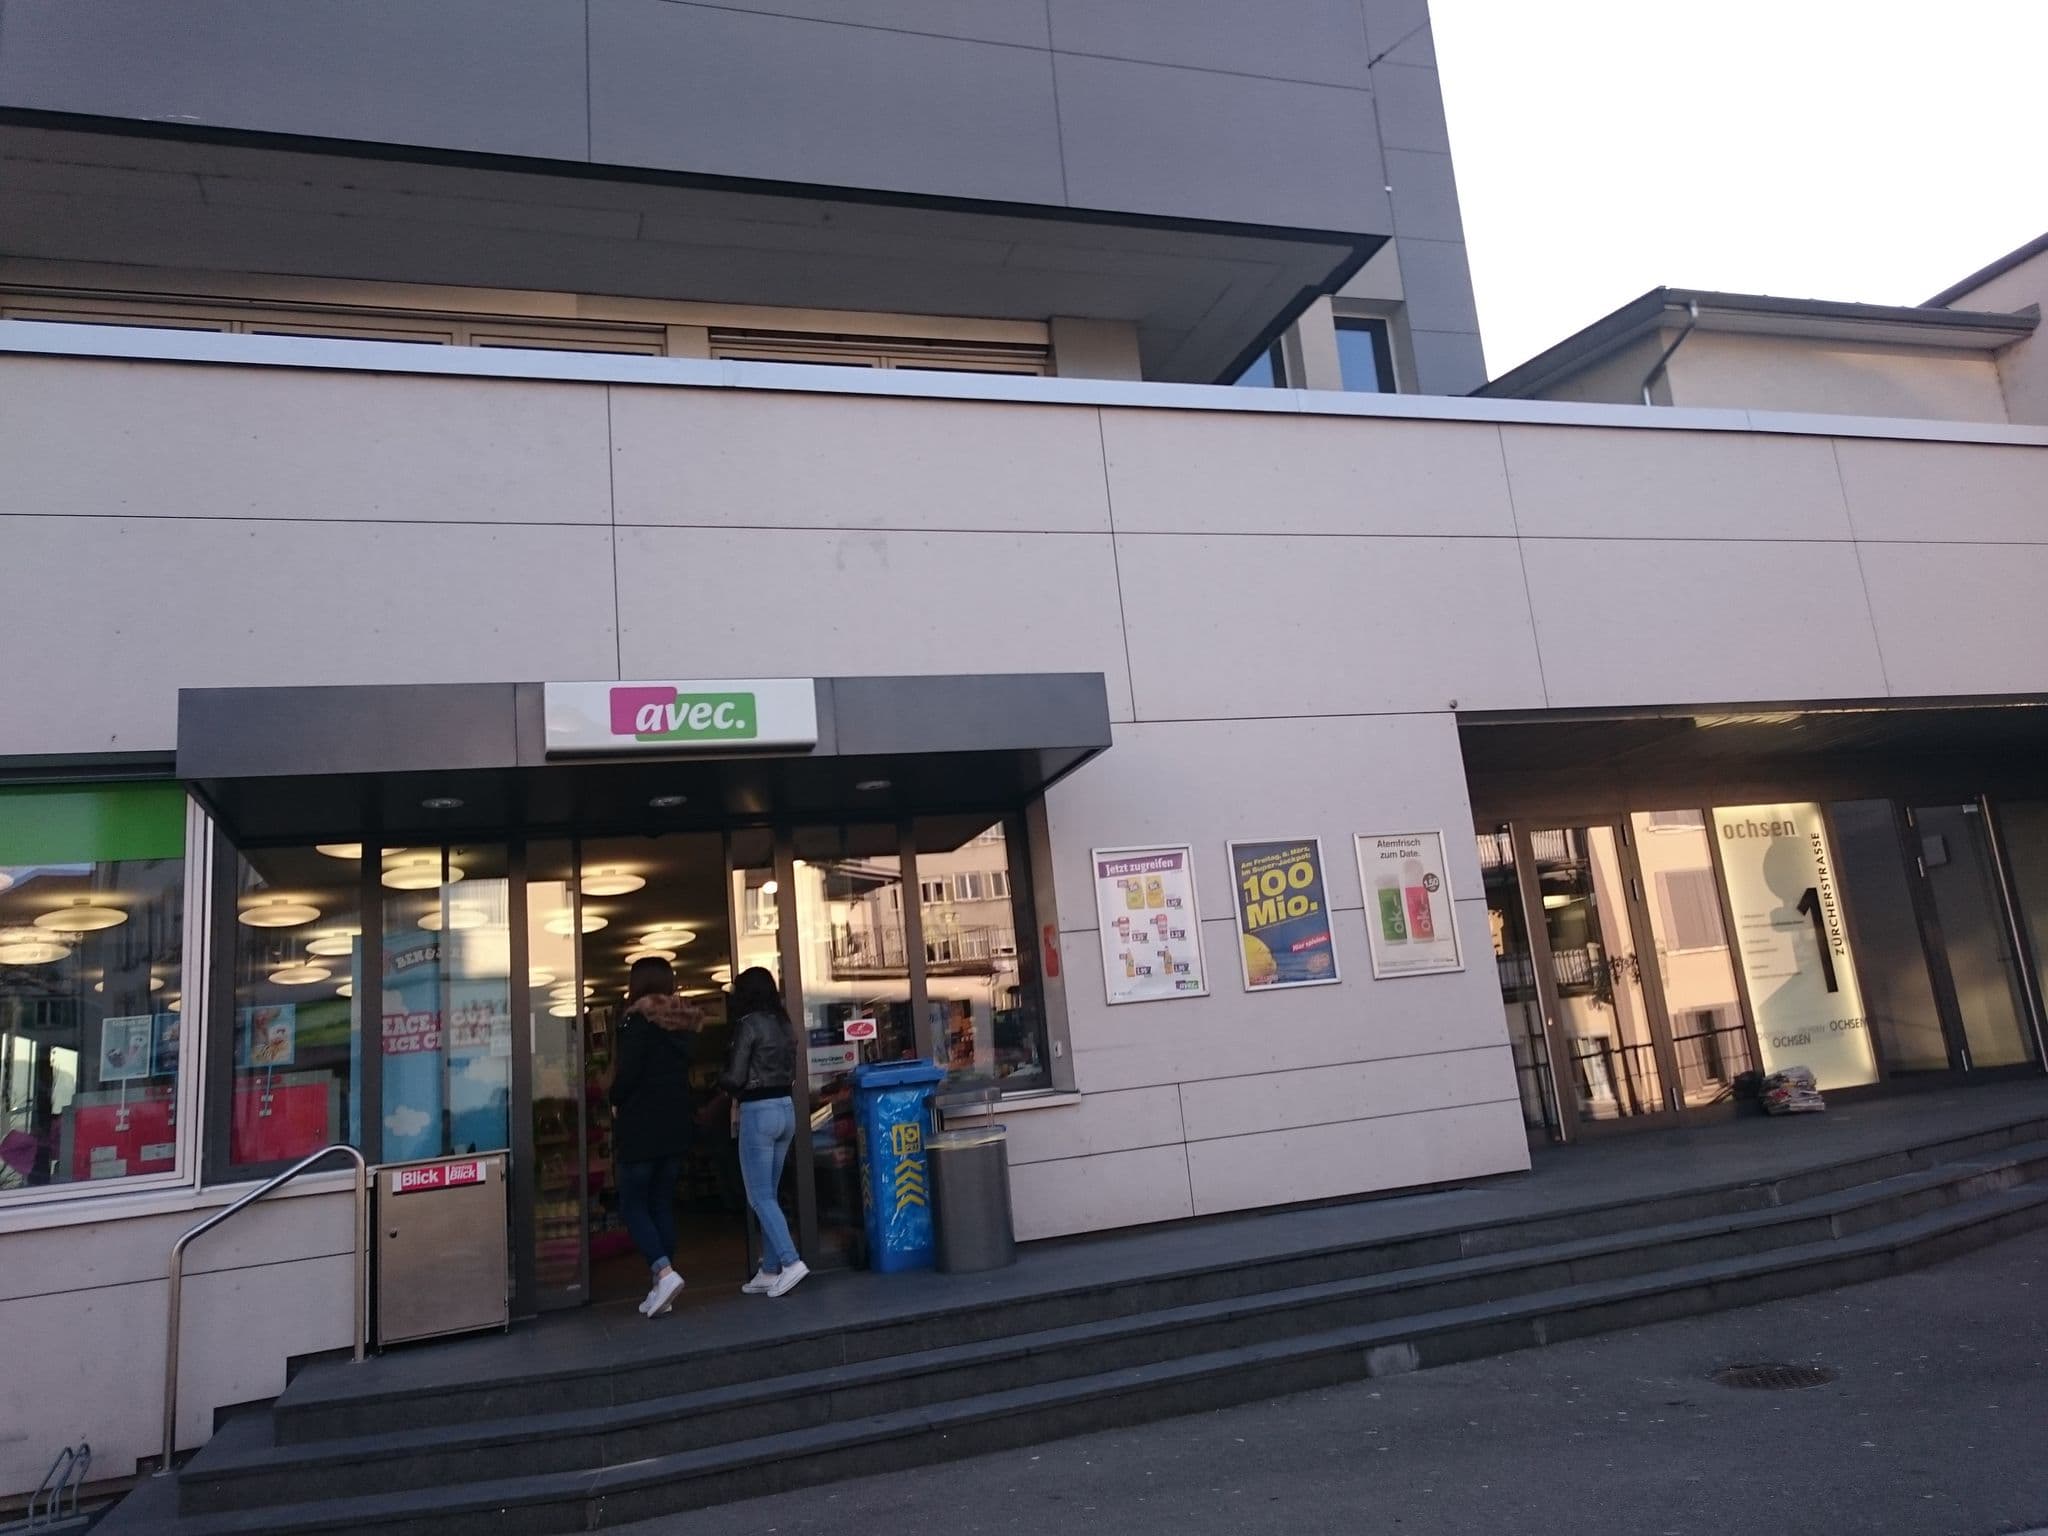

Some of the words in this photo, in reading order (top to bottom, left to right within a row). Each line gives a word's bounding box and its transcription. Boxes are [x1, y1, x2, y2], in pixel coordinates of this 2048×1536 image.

[636, 701, 746, 732] avec.
[1723, 819, 1796, 840] ochsen
[1377, 839, 1421, 848] Atemfrisch
[1380, 851, 1398, 859] zum
[1105, 863, 1129, 876] Jetzt
[1130, 858, 1174, 873] zugreifen
[1243, 861, 1314, 901] 100
[1811, 832, 1845, 956] ZÜRCHERSTRASSE
[1246, 895, 1318, 930] Mio.
[1797, 887, 1838, 993] 1
[382, 1014, 438, 1036] EACE,
[1772, 1032, 1811, 1048] OCHSEN
[402, 1170, 439, 1186] Blick
